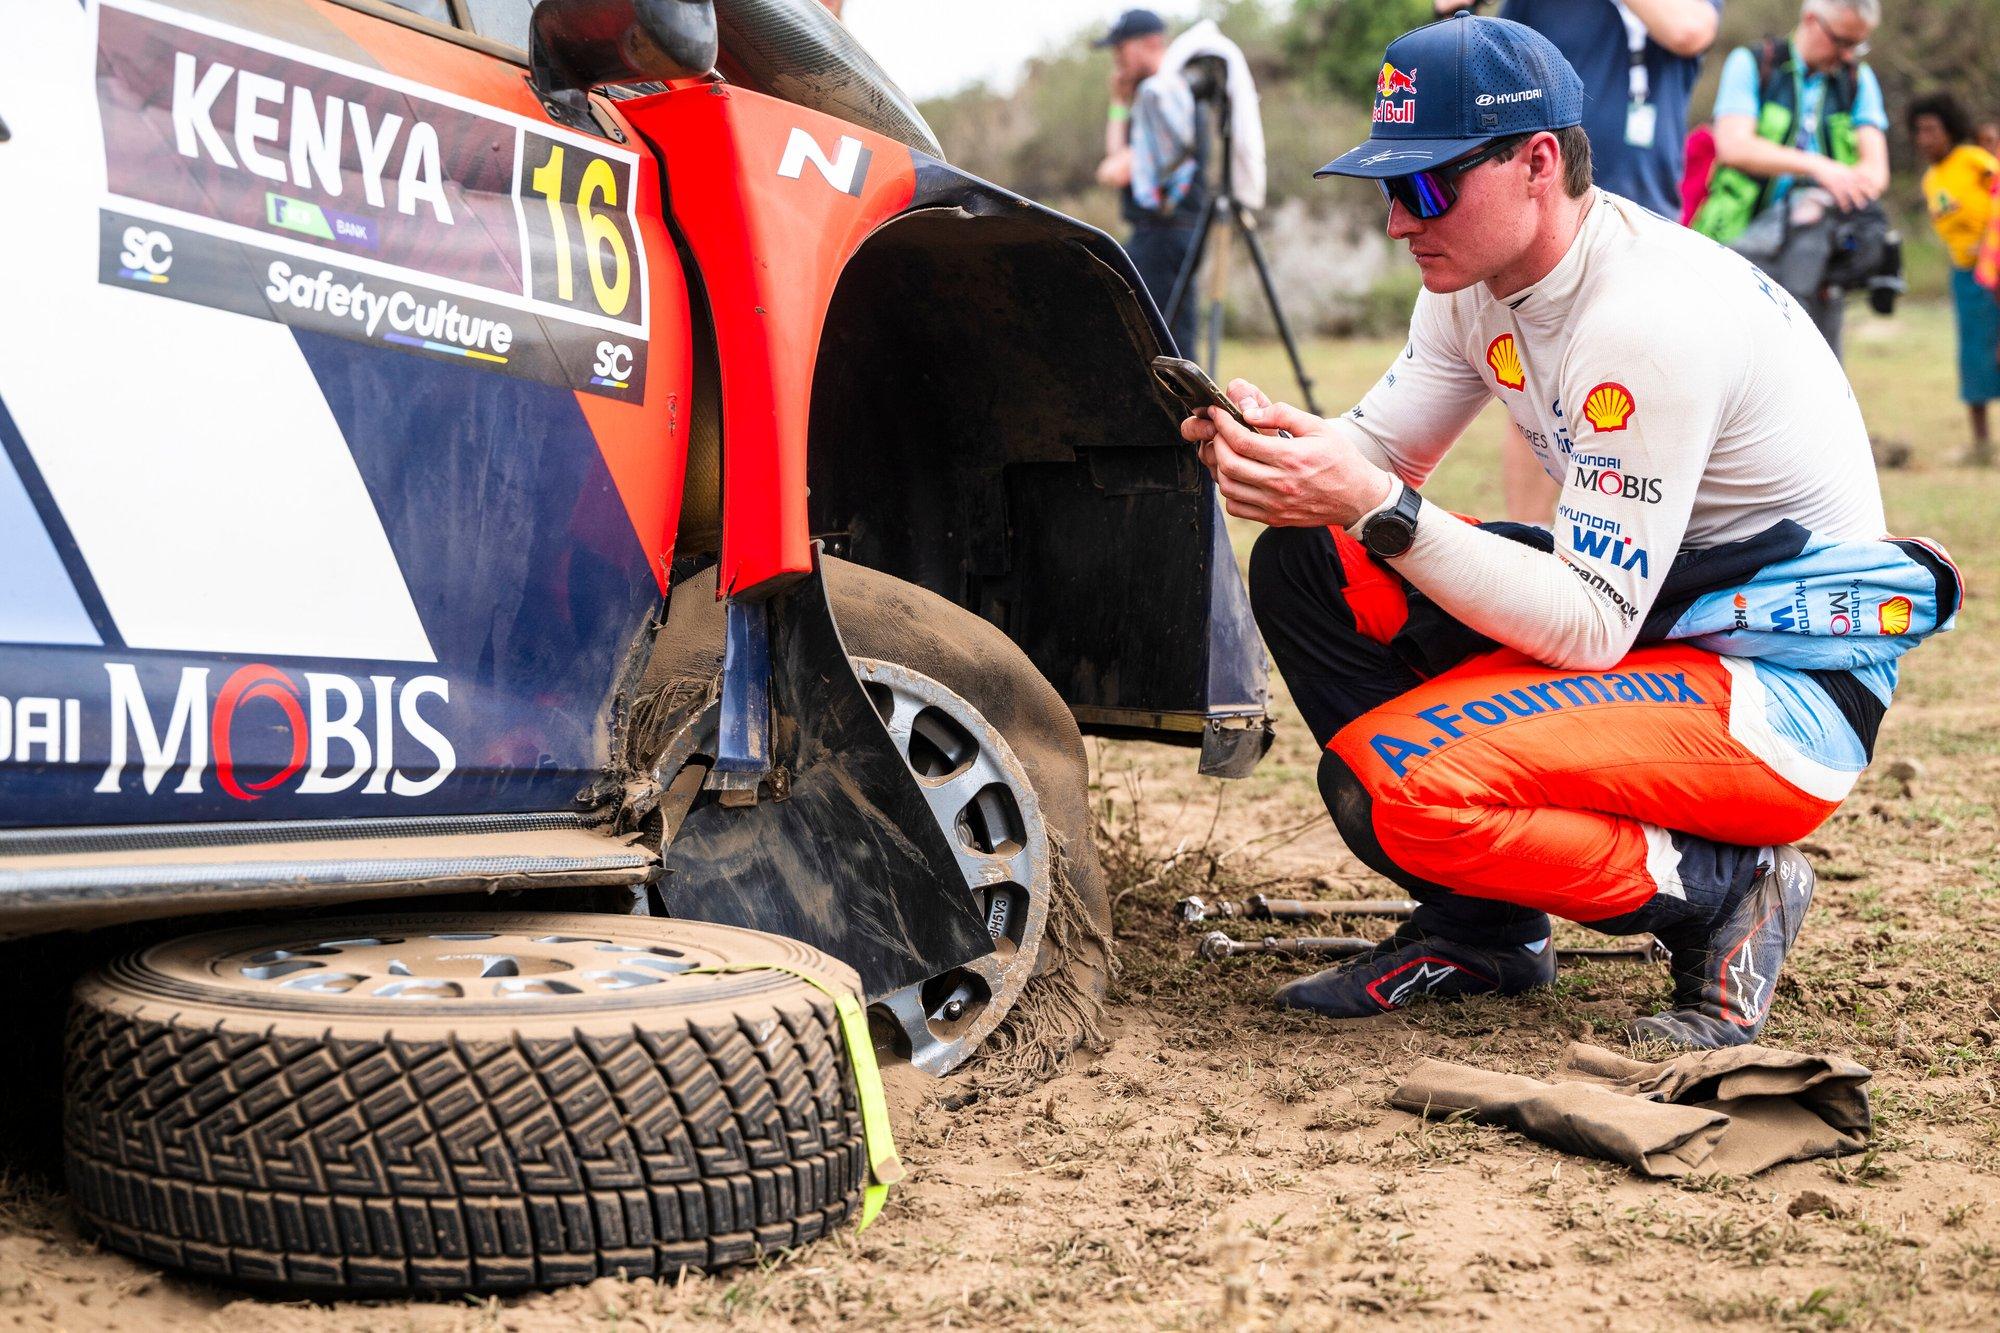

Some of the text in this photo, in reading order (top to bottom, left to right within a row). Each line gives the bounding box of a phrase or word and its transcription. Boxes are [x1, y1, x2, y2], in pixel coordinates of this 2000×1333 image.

[1385, 100, 1415, 123] Bull
[1497, 89, 1542, 104] HYUNDAI
[172, 51, 454, 225] KENYA
[119, 226, 173, 274] SC
[336, 219, 368, 239] BANK
[533, 145, 630, 316] 16
[266, 261, 513, 354] SafetyCulture
[593, 341, 633, 381] SC
[1574, 466, 1663, 504] MOBIS
[1851, 579, 1863, 632] HYUNDAI
[94, 662, 457, 800] MOBIS
[1369, 672, 1707, 779] A.Fourmaux
